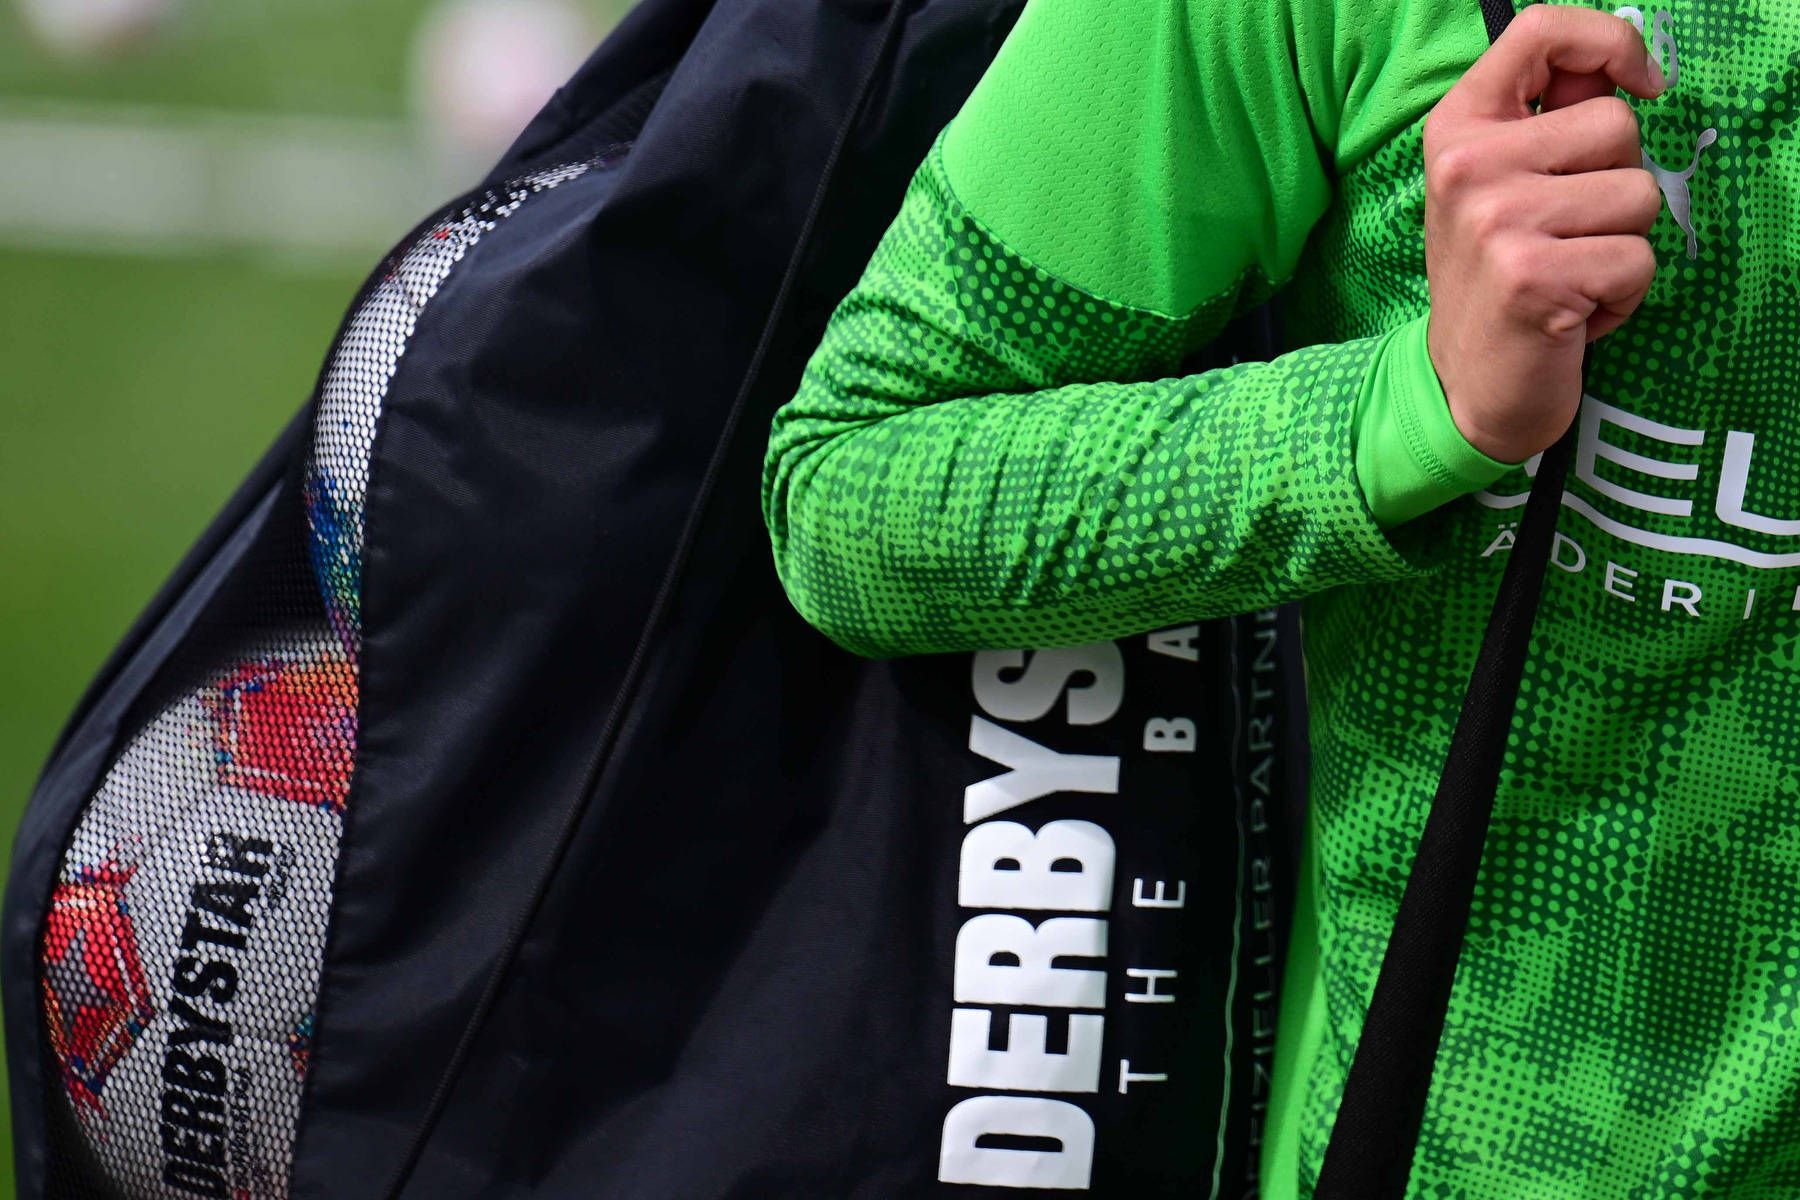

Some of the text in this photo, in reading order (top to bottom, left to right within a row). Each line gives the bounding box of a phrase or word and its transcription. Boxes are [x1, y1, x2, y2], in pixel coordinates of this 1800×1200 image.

[1613, 5, 1679, 89] 6
[162, 830, 274, 1198] DERBYSTAR
[1118, 877, 1187, 1094] THE
